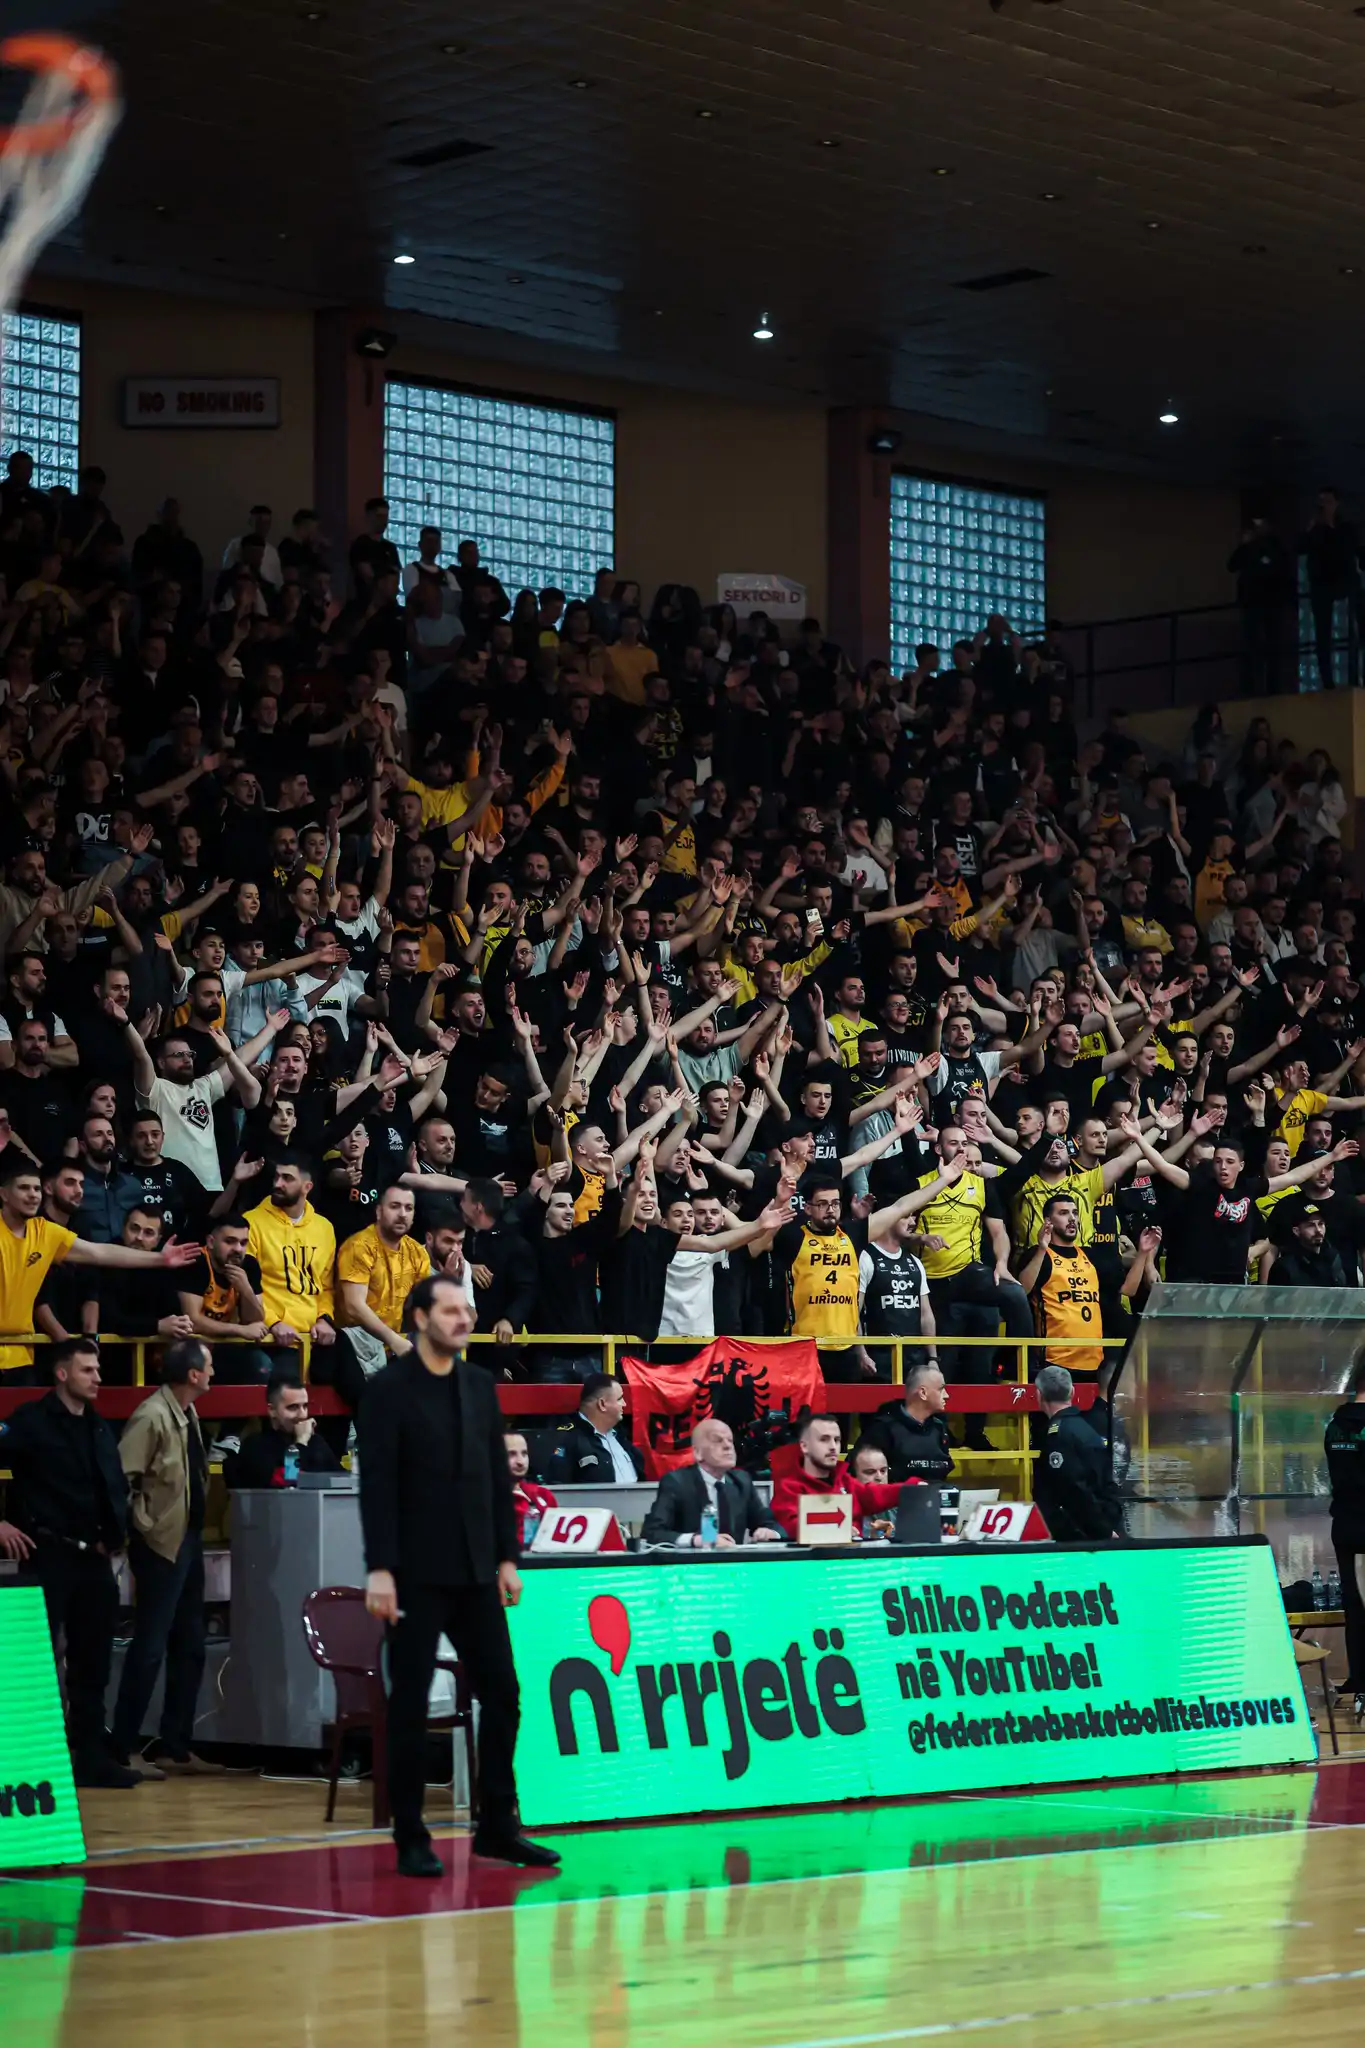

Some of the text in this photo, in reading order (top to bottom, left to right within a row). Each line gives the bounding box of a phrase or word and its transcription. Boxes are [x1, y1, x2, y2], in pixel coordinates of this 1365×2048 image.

[138, 391, 265, 413] NO SMOKING
[724, 589, 803, 604] SEKTORI D
[815, 1145, 838, 1159] EJA
[810, 1253, 851, 1267] PEJA
[825, 1270, 838, 1285] 4
[880, 1294, 920, 1310] PEJA
[1081, 1305, 1093, 1322] 0
[552, 1514, 588, 1544] 5
[979, 1507, 1013, 1535] 5
[882, 1581, 1119, 1636] Shiko Podcast
[940, 1643, 1103, 1697] YouTube!
